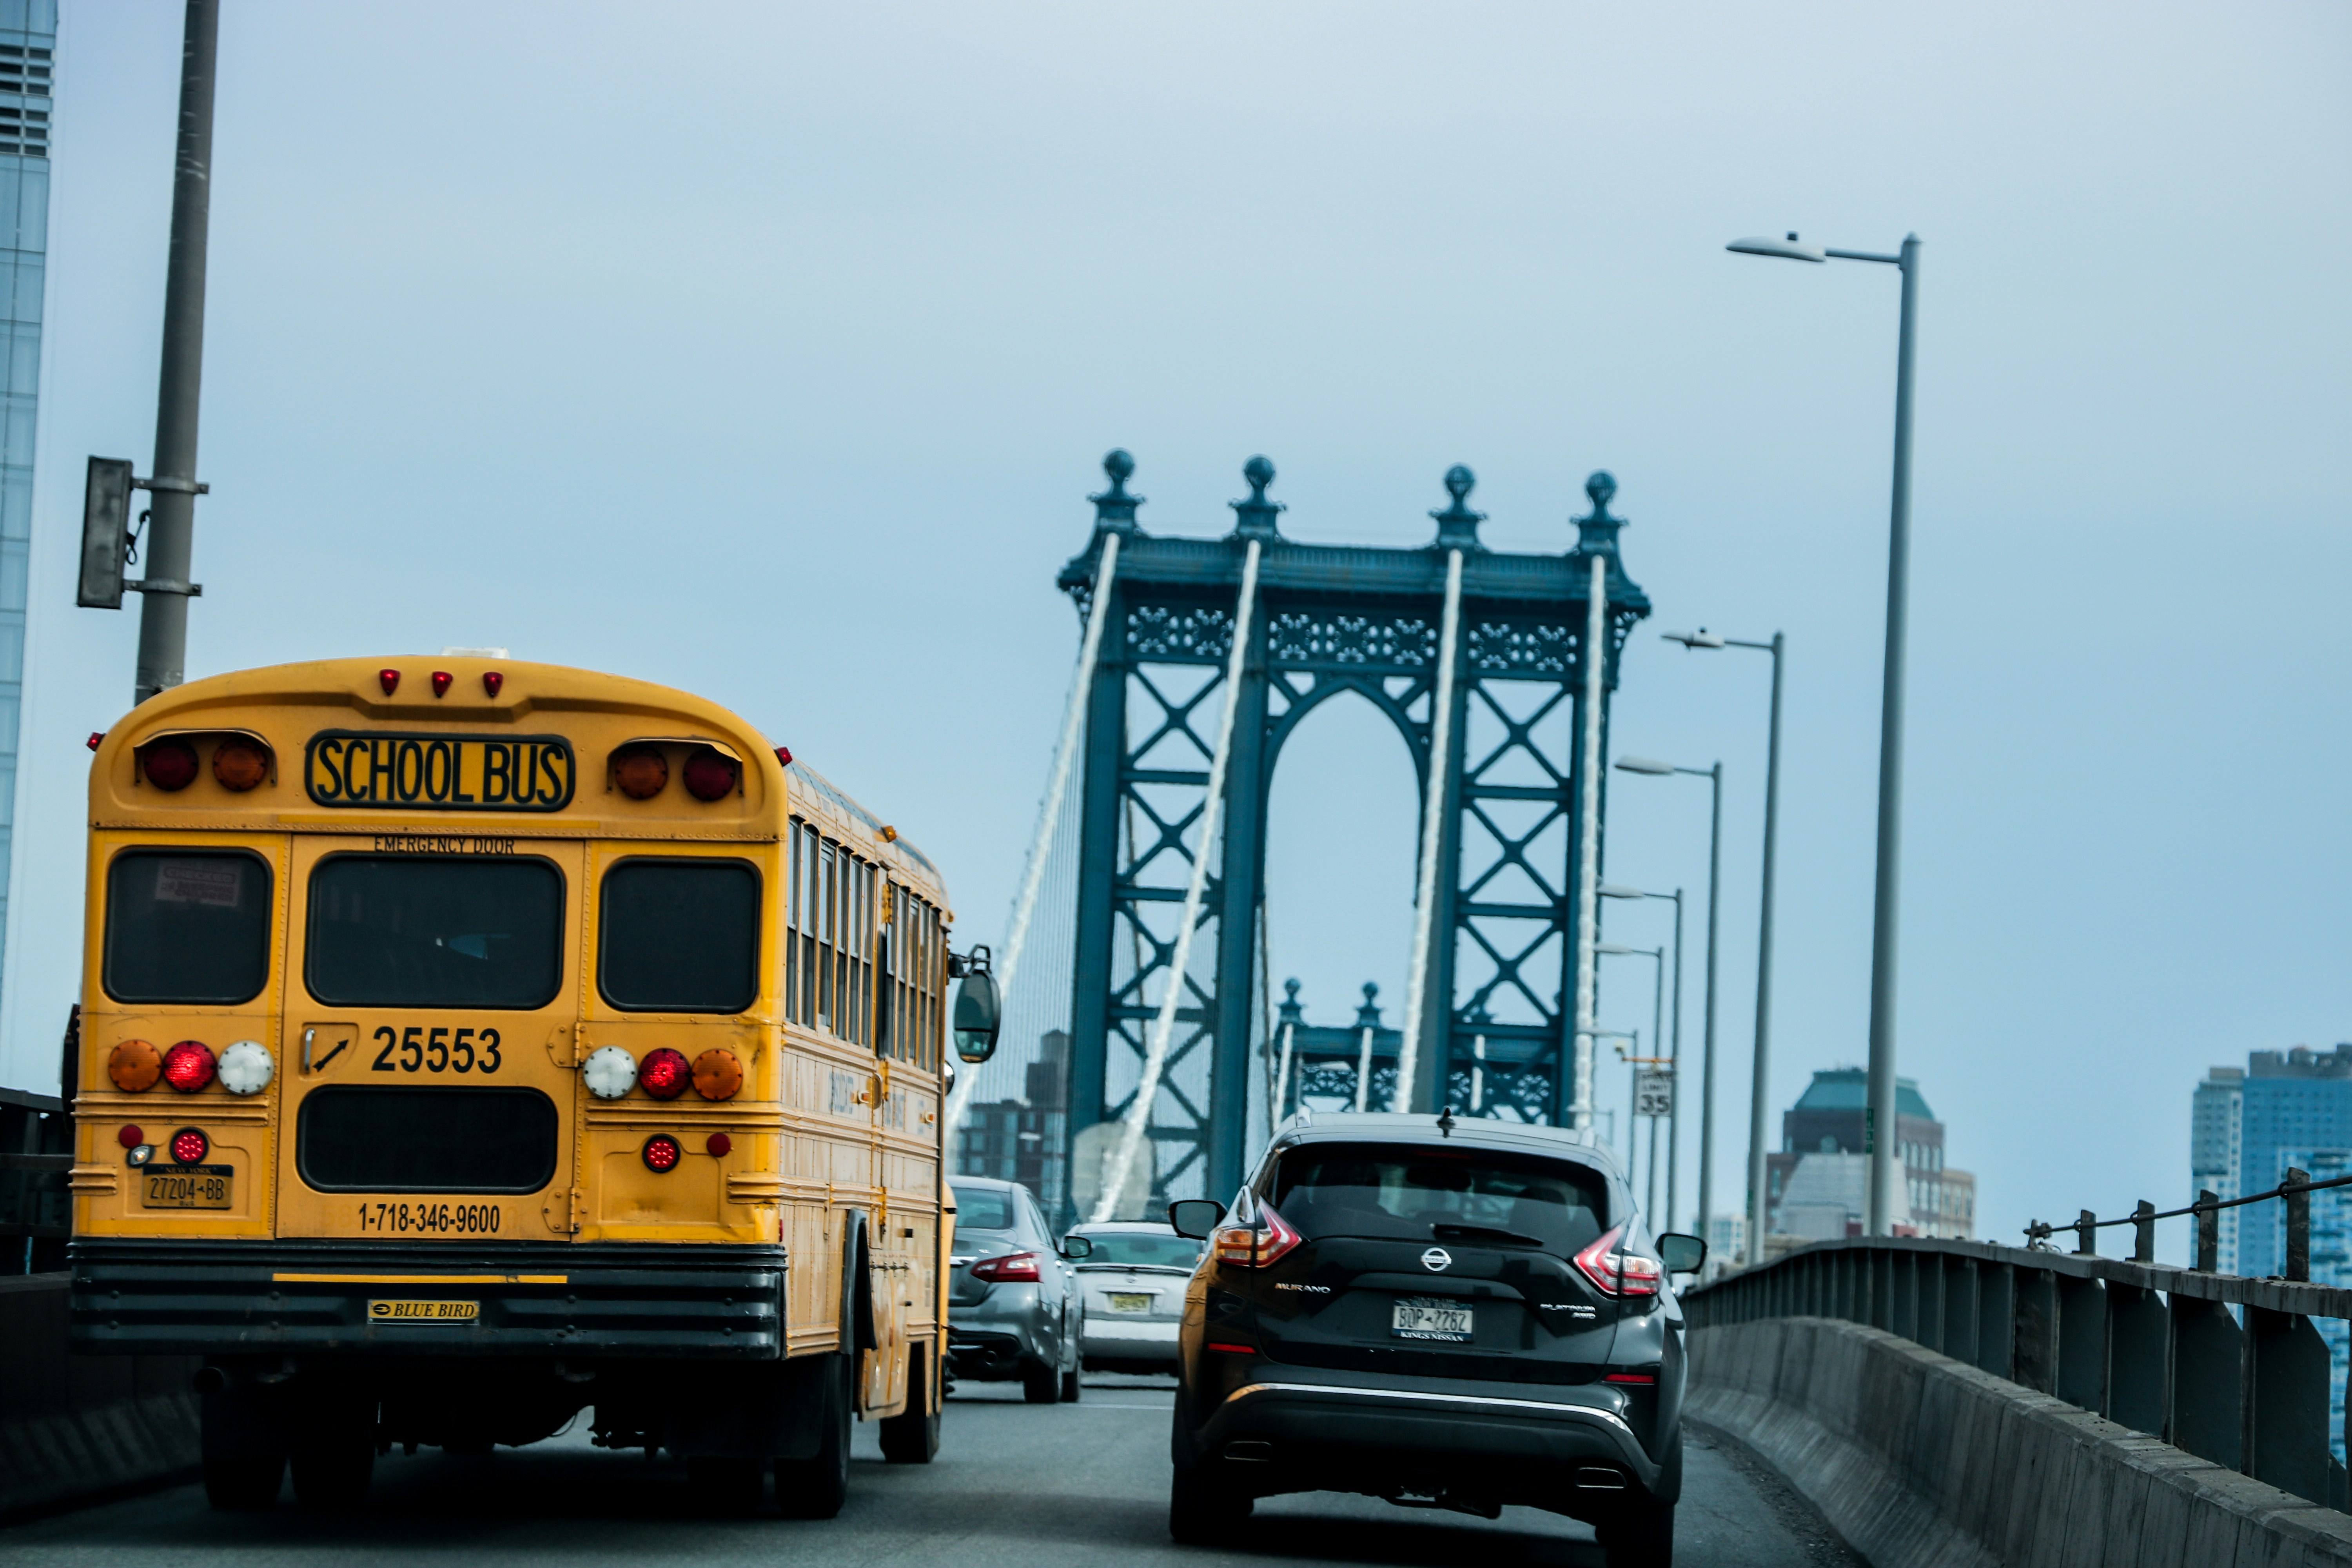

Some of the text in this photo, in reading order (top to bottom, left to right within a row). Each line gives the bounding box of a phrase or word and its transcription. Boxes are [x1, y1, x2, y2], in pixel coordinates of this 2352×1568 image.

[317, 738, 563, 804] SCHOOL BUS
[374, 836, 515, 855] EMERGENCY DOOR
[371, 1026, 501, 1074] 25553
[1640, 1094, 1670, 1112] 35
[359, 1203, 500, 1233] 1-718-346-9600
[1275, 1282, 1331, 1294] MURANO
[394, 1303, 475, 1317] BLUE BIRD
[1400, 1331, 1464, 1341] KINGS NISSAN
